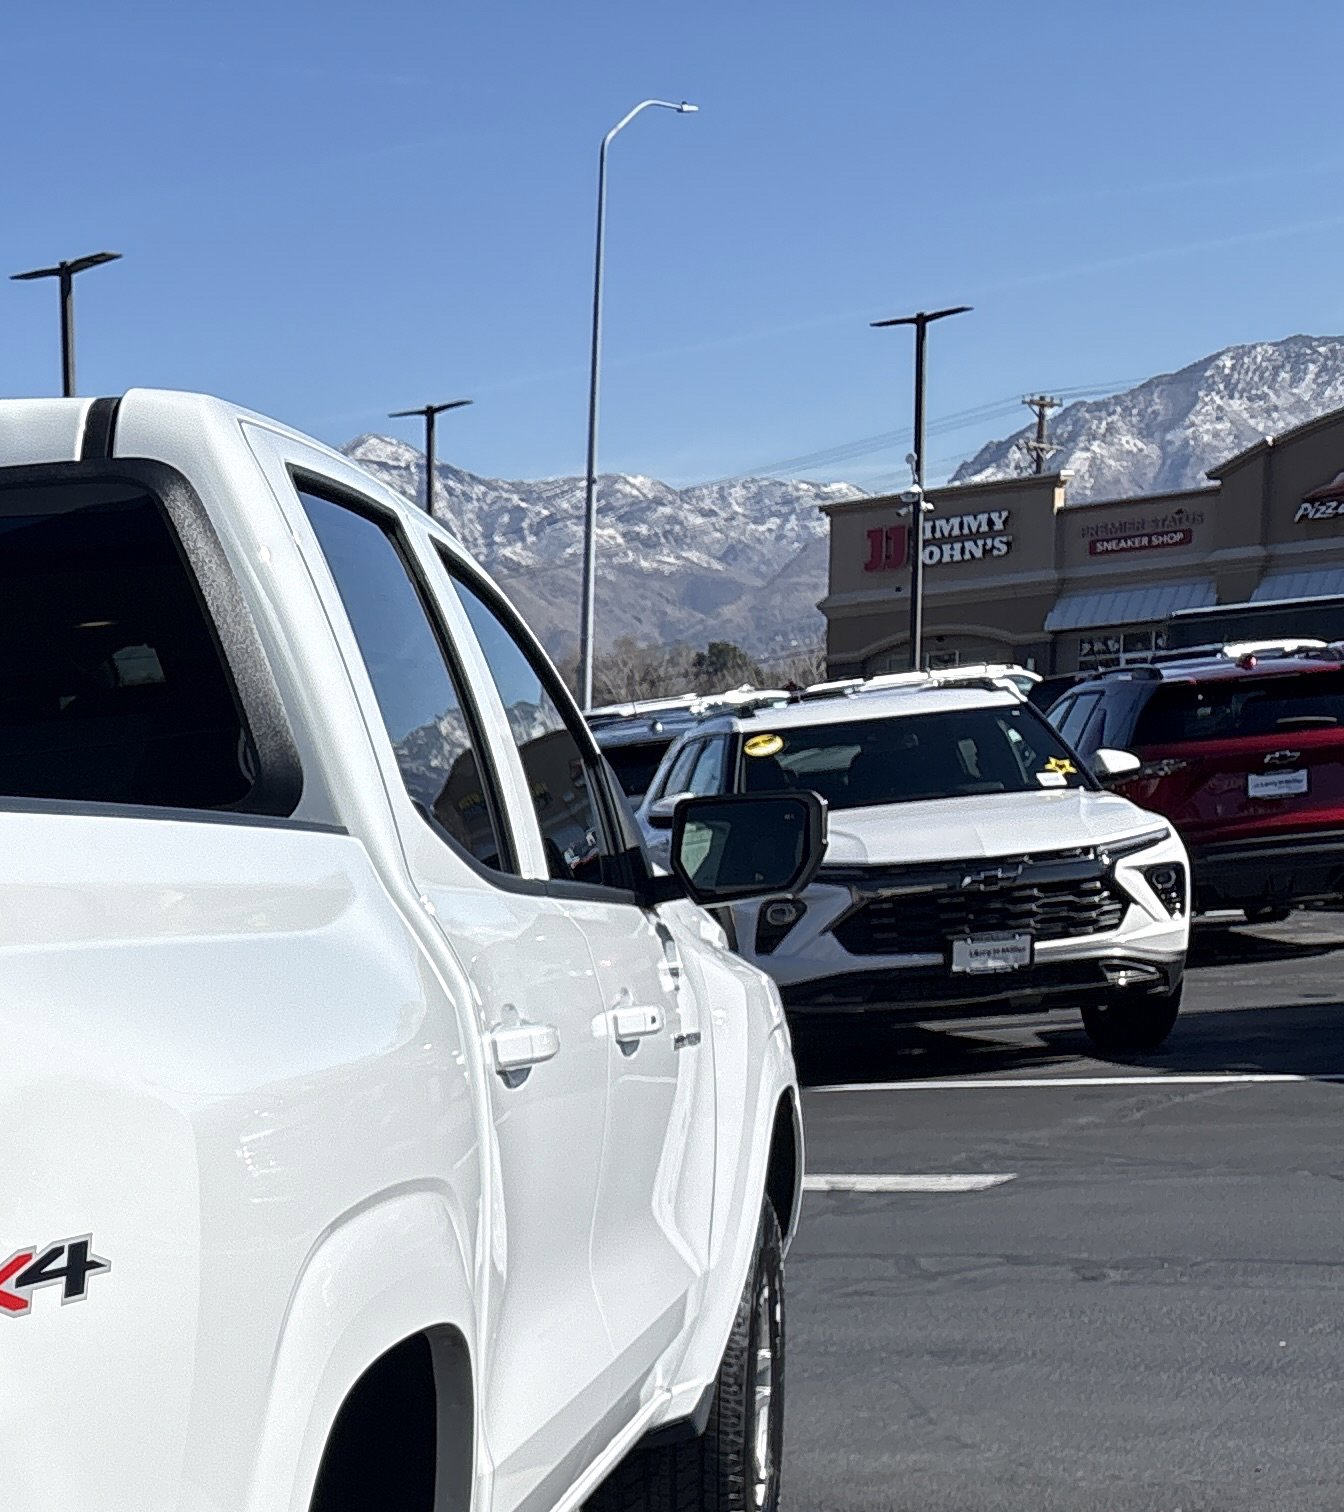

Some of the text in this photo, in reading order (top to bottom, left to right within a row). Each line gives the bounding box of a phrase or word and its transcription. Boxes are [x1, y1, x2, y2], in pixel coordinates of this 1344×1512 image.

[923, 510, 1010, 540] IMMY
[923, 535, 1009, 566] OHN'S
[1095, 531, 1185, 553] SNEAKER SHOP
